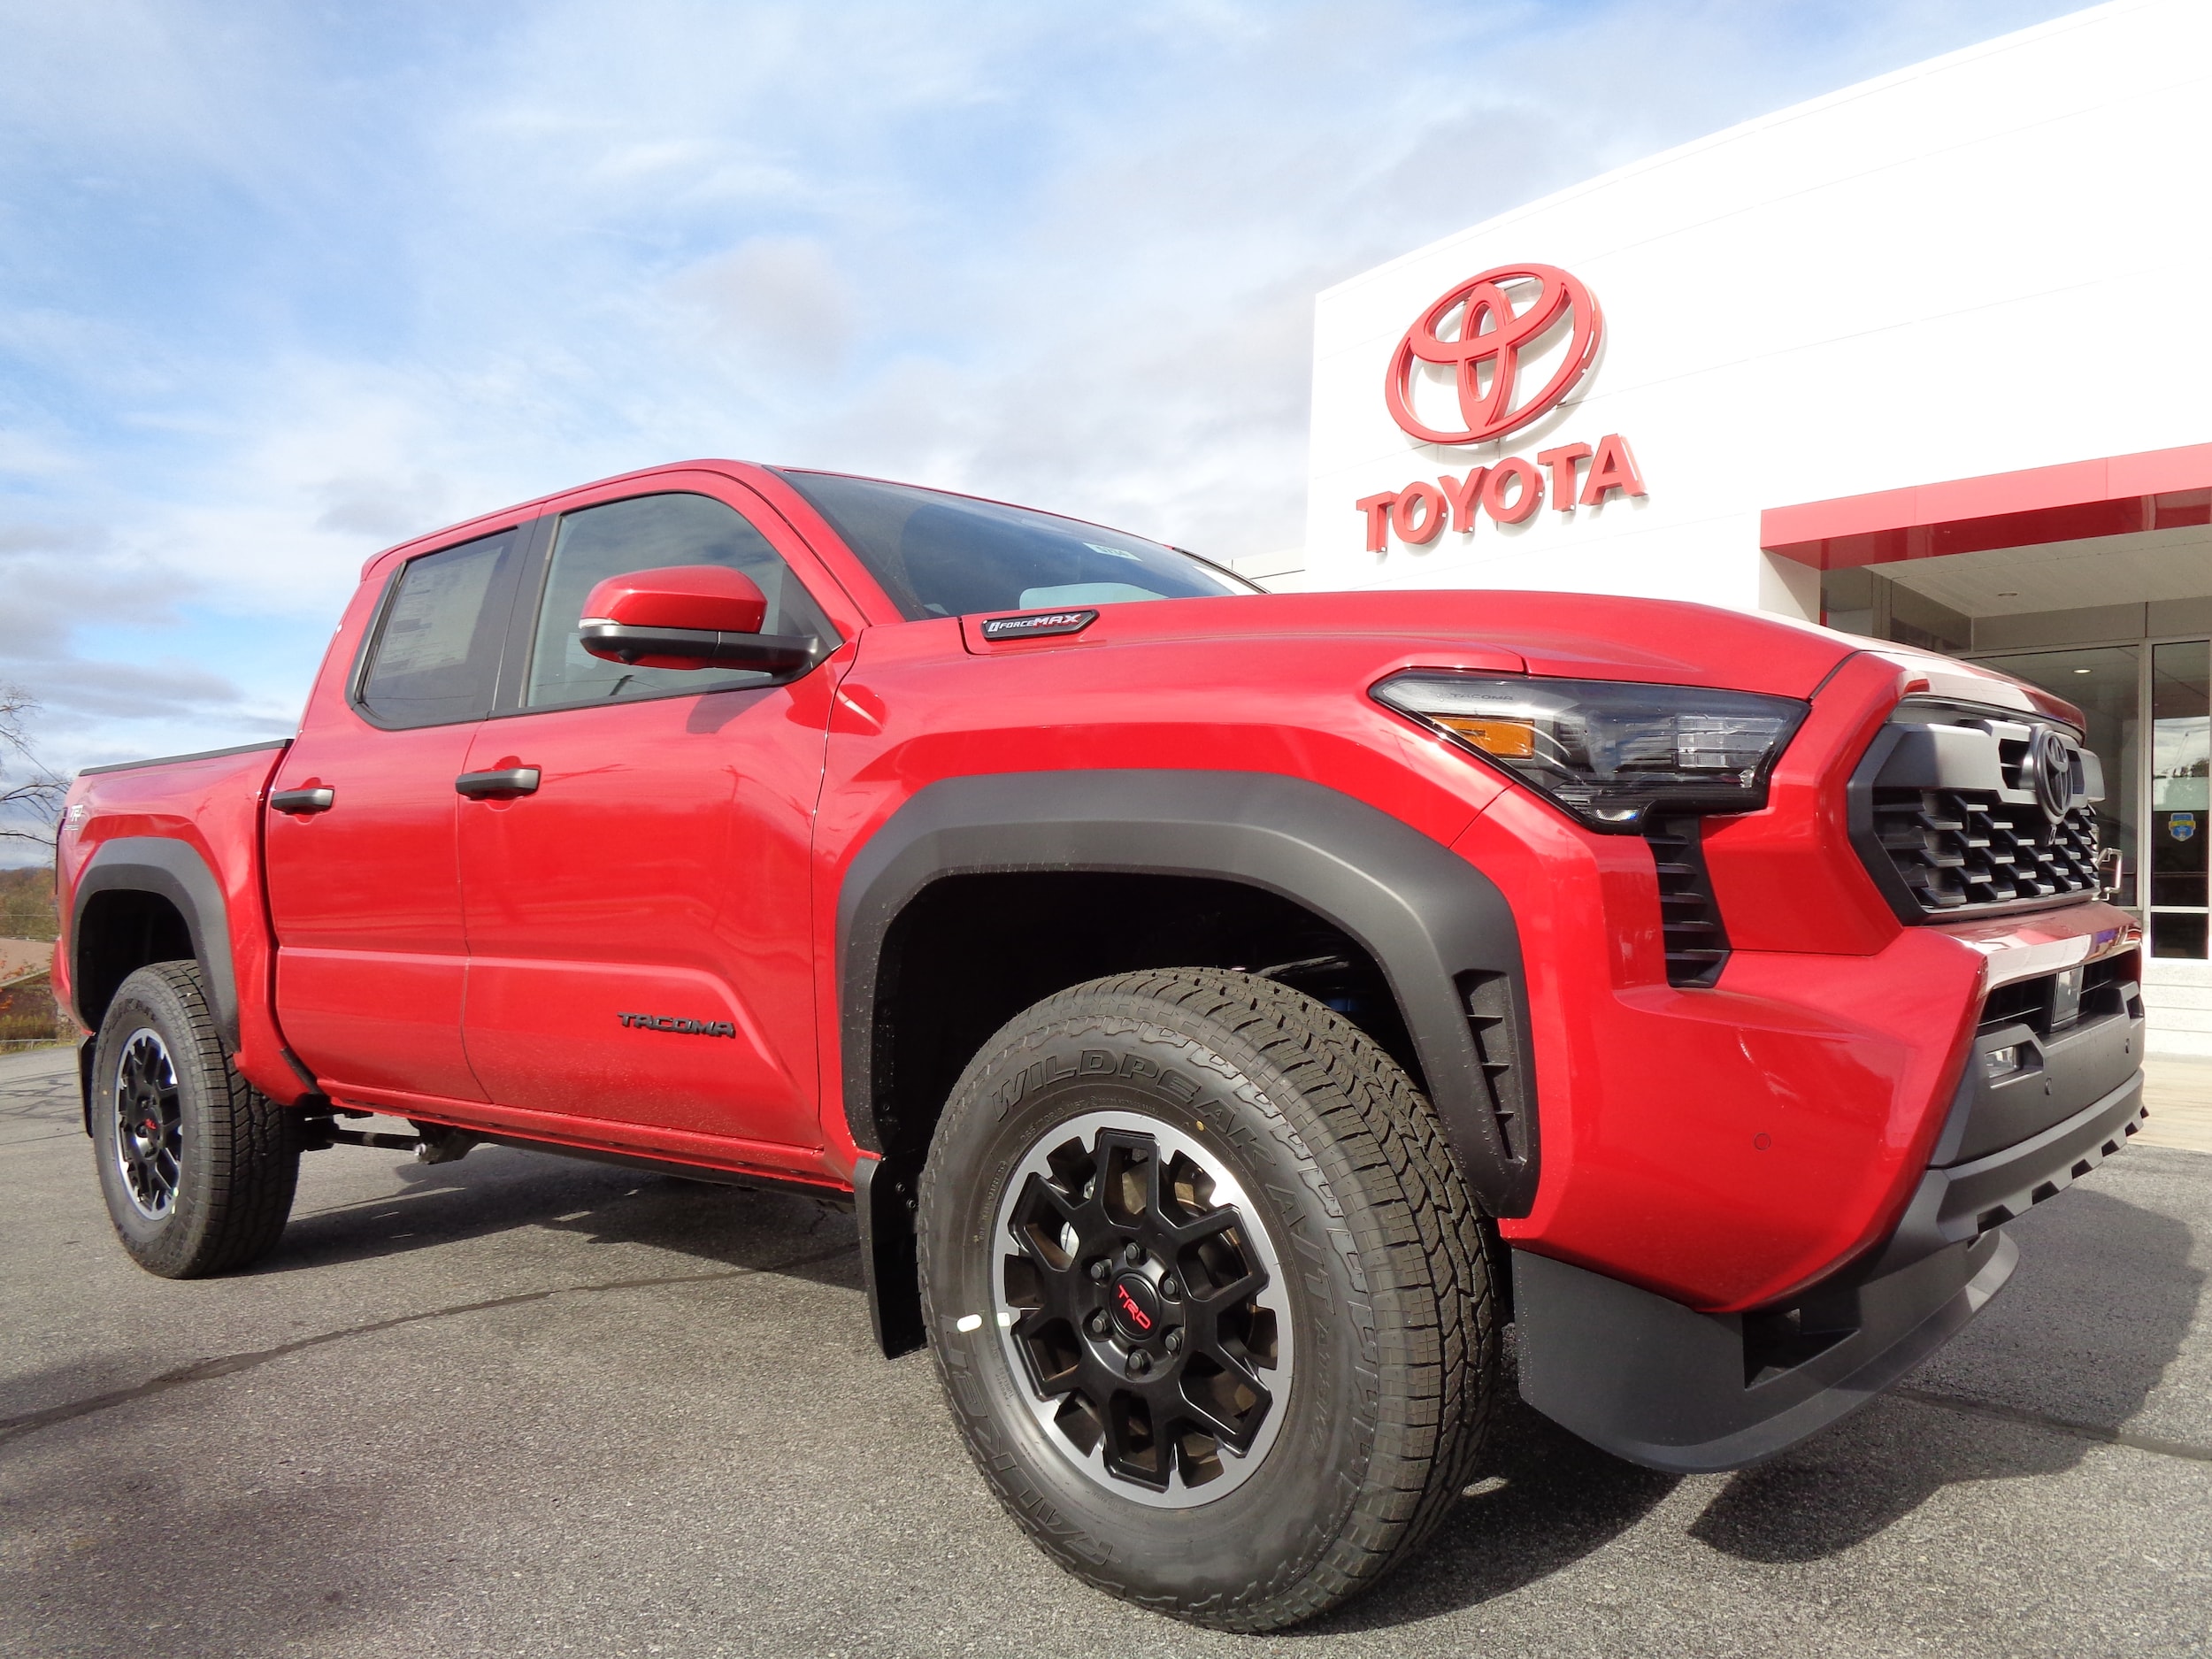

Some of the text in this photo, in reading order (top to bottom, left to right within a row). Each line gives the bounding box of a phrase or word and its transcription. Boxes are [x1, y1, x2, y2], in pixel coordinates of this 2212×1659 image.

[1356, 434, 1648, 553] TOYOTA
[617, 1011, 736, 1039] TACOMA
[988, 1049, 1336, 1315] WILDPEAK A/T
[1118, 1284, 1151, 1330] TRD
